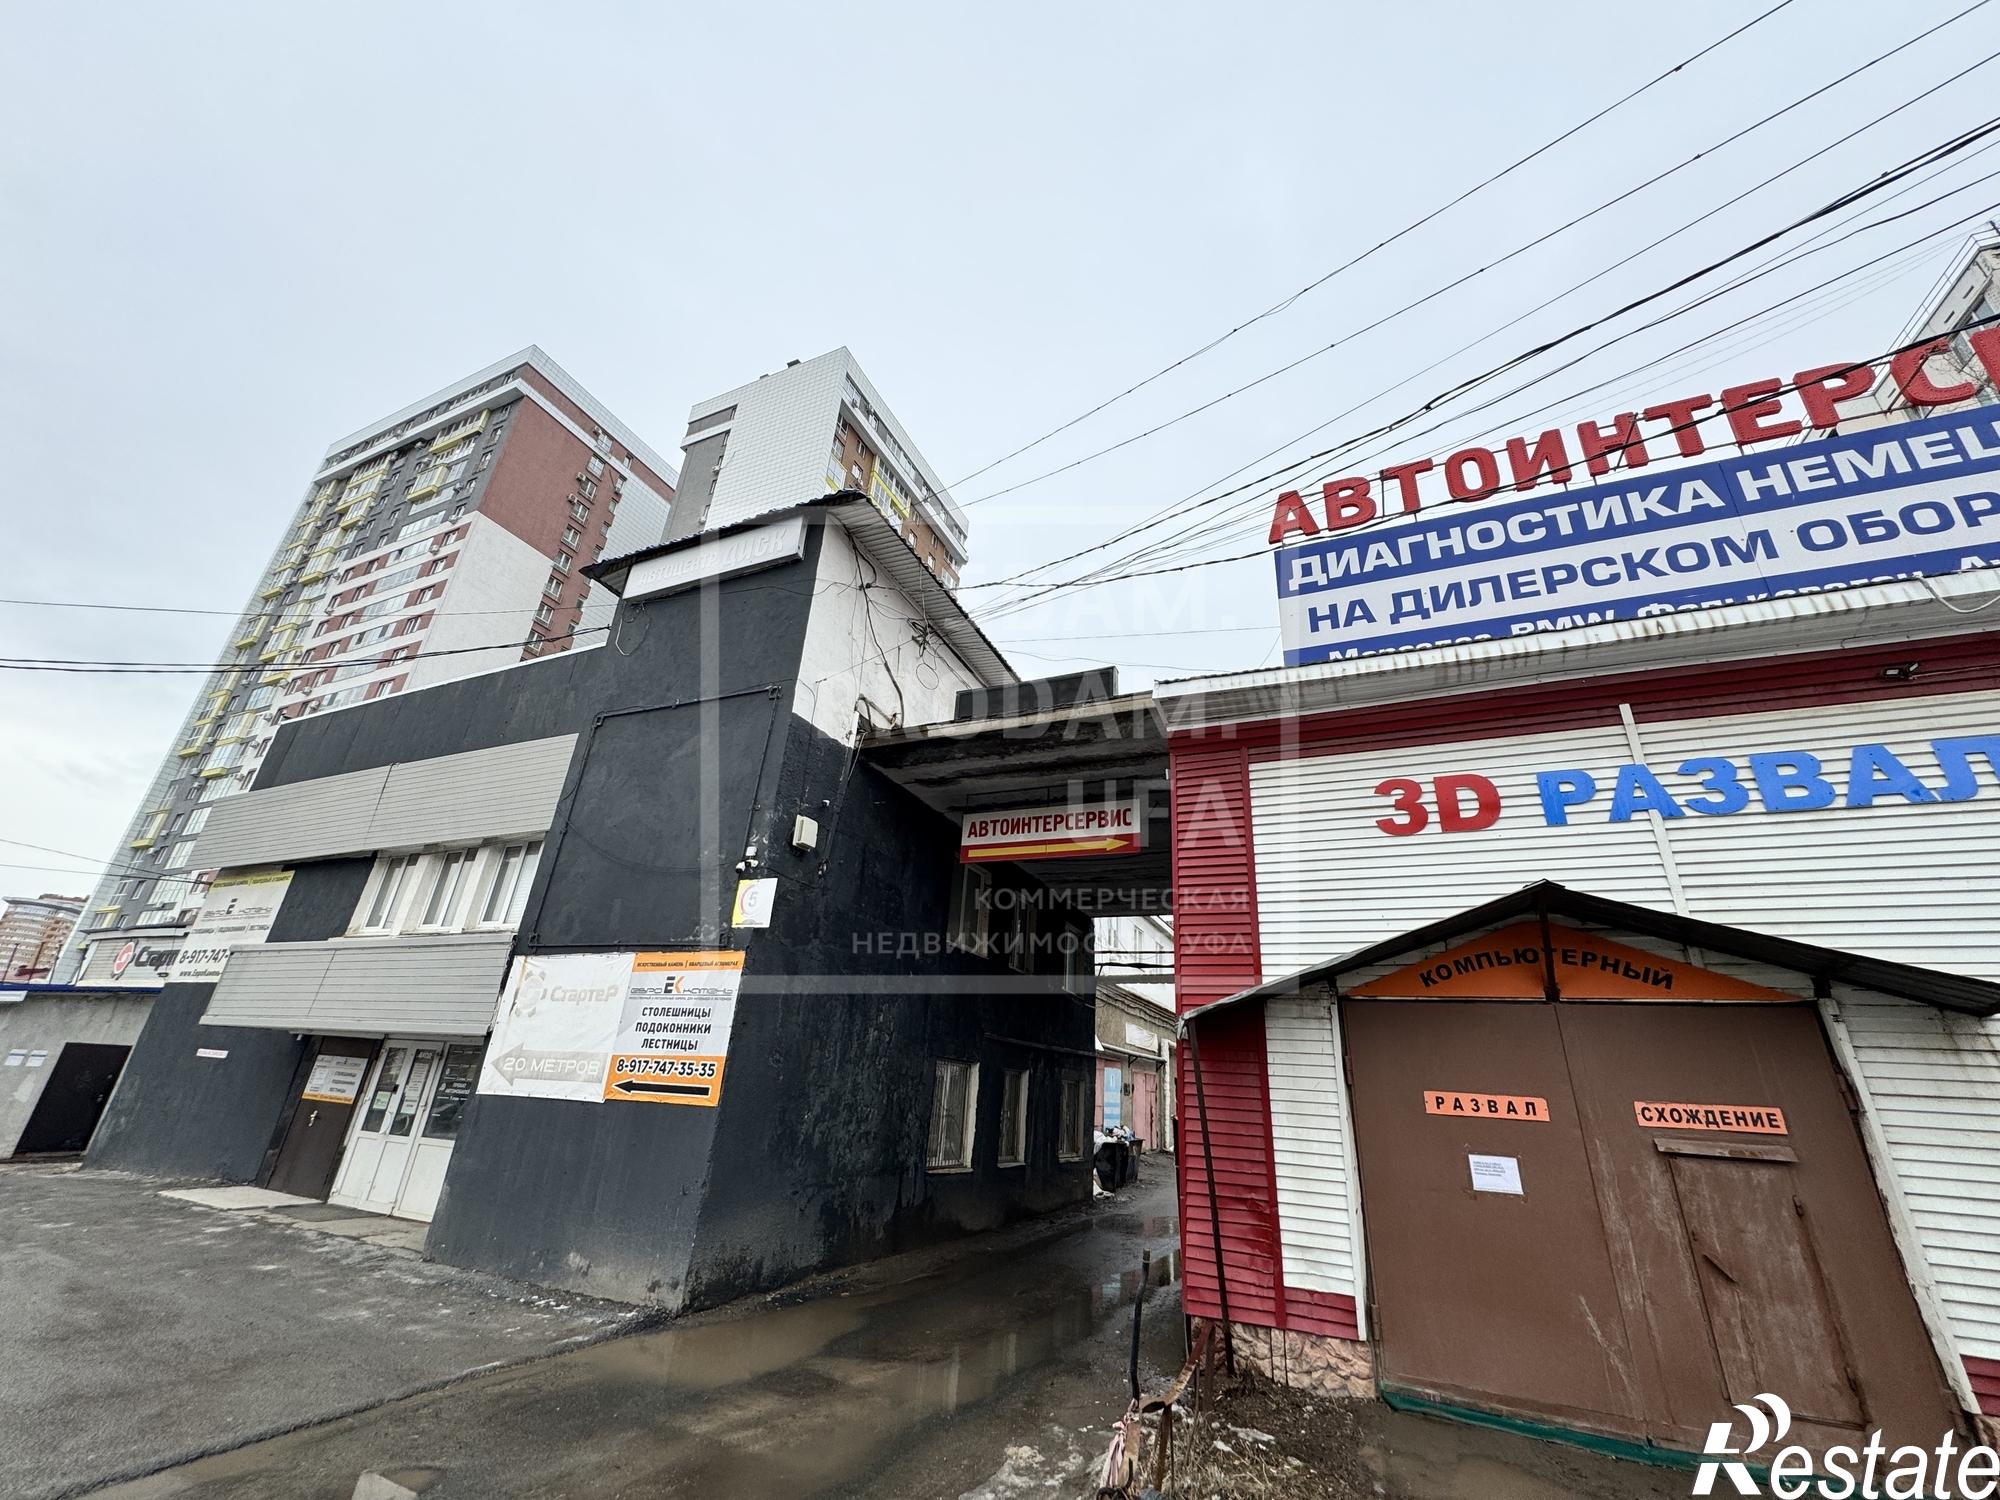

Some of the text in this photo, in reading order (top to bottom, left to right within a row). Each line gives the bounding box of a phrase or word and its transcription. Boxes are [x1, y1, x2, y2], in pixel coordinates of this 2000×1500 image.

[1289, 477, 1724, 590] ДИАГНОСТИКА
[1307, 602, 1377, 634] НА
[1390, 529, 1780, 624] ДИЛЕРСКОМ
[1796, 491, 2000, 553] ОБОР
[1374, 735, 2000, 836] 3D РАЗВАЛ
[967, 806, 1133, 839] АВТОИНТЕРСЕРВИС
[641, 1006, 712, 1018] СТОЛЕШНИЦЫ
[635, 1022, 712, 1034] ПОДОКОННИКИ
[641, 1038, 699, 1051] ЛЕСТНИЦЫ
[503, 1057, 600, 1076] 20 МЕТРОВ
[616, 1058, 716, 1077] 8-917-747-35-35
[1435, 1095, 1538, 1116] РАЗВАЛ
[1641, 1106, 1781, 1128] СХОЖДЕНИЕ
